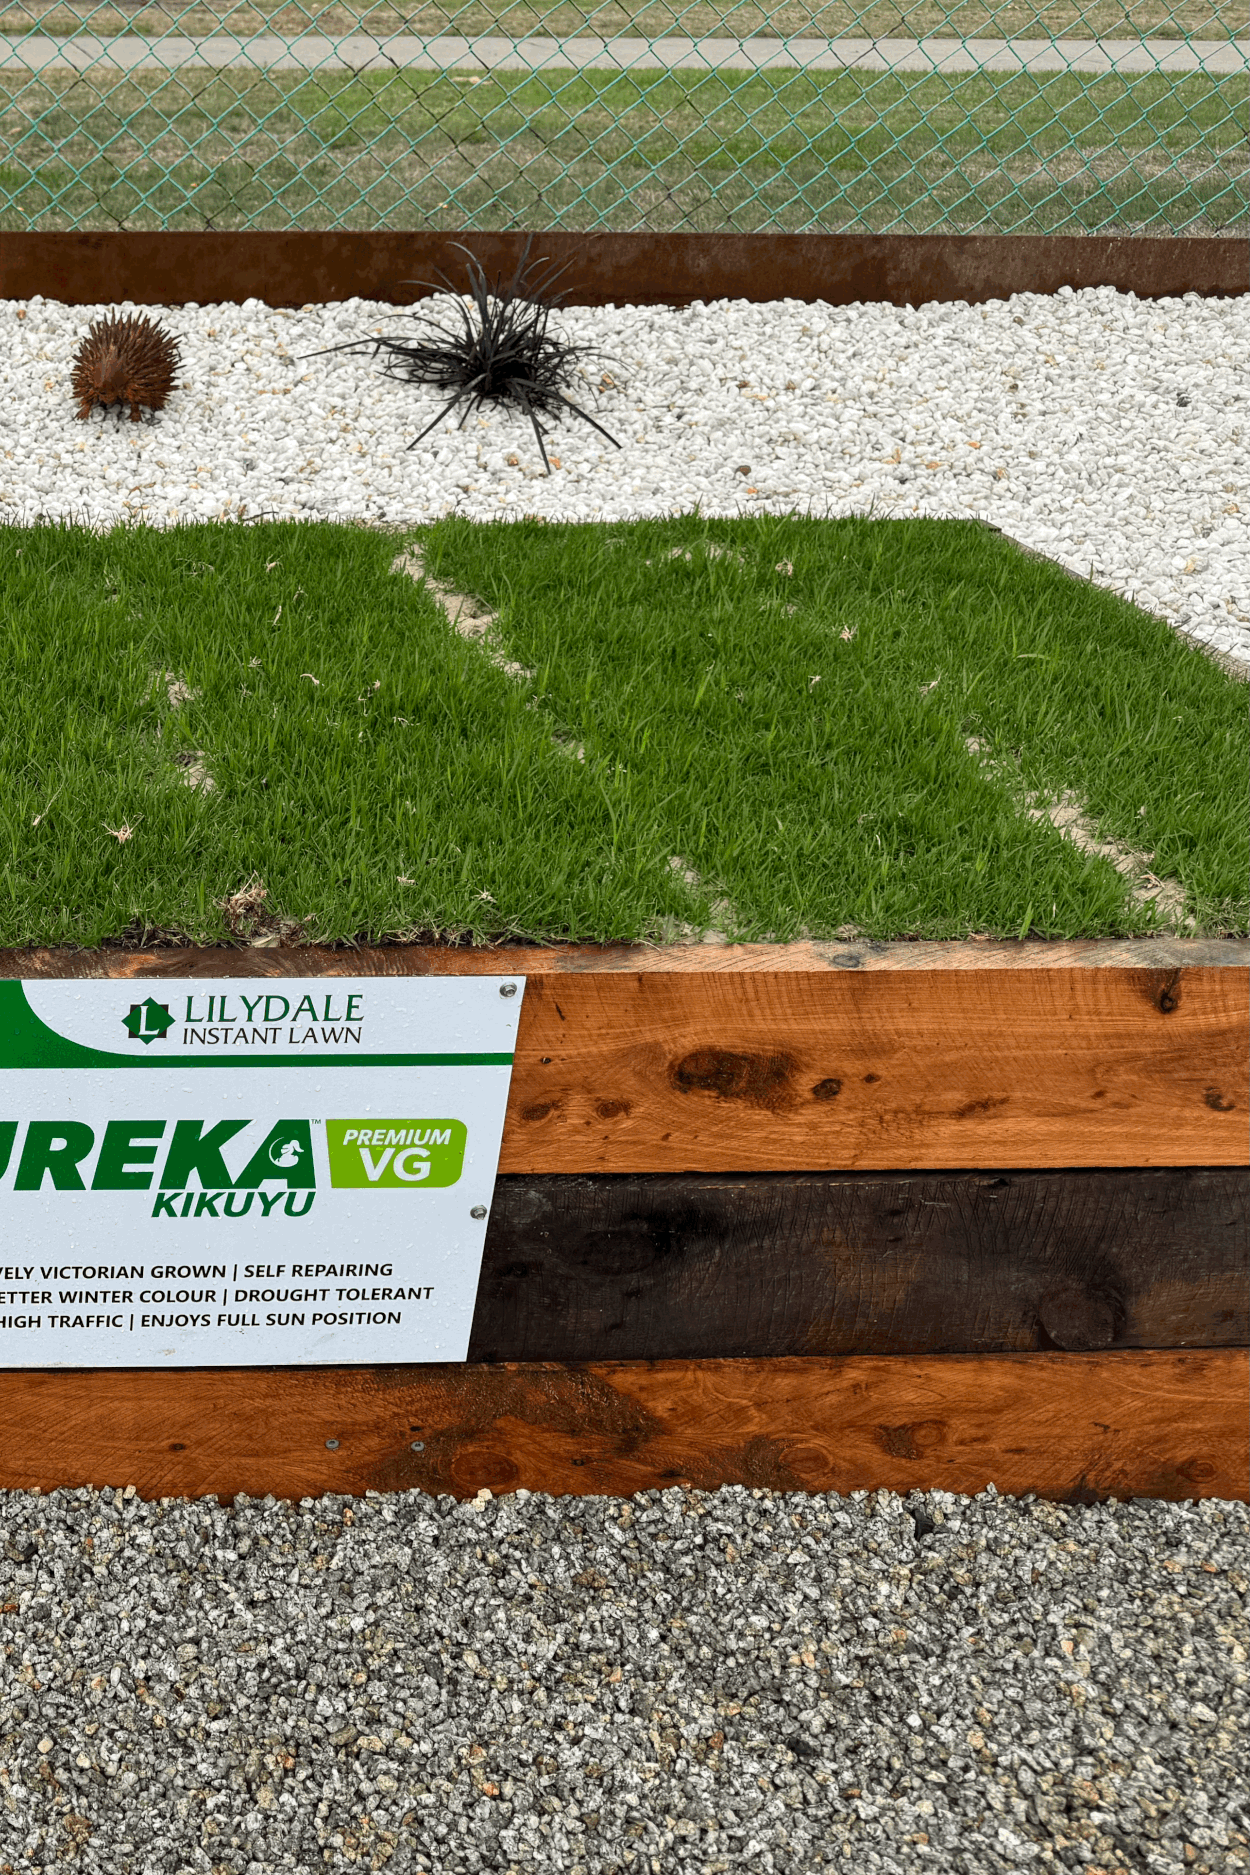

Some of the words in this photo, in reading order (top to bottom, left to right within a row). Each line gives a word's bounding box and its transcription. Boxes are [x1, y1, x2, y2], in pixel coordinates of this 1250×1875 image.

[184, 994, 365, 1023] LILYDALE
[138, 1005, 160, 1036] L
[182, 1027, 282, 1045] INSTANT
[288, 1026, 362, 1044] LAWN
[342, 1128, 452, 1146] PREMIUM
[358, 1147, 432, 1181] VG
[151, 1191, 317, 1218] KIKUYU
[40, 1266, 144, 1280] VICTORIAN
[150, 1265, 226, 1279] GROWN
[244, 1264, 286, 1278] SELF
[291, 1263, 393, 1277] REPAIRING
[58, 1290, 134, 1304] WINTER
[139, 1290, 217, 1303] COLOUR
[234, 1289, 330, 1303] DROUGHT
[335, 1287, 435, 1301] TOLERANT
[48, 1315, 123, 1328] TRAFFIC
[141, 1314, 211, 1328] ENJOYS
[217, 1314, 260, 1327] FULL
[265, 1313, 305, 1326] SUN
[311, 1312, 402, 1326] POSITION
